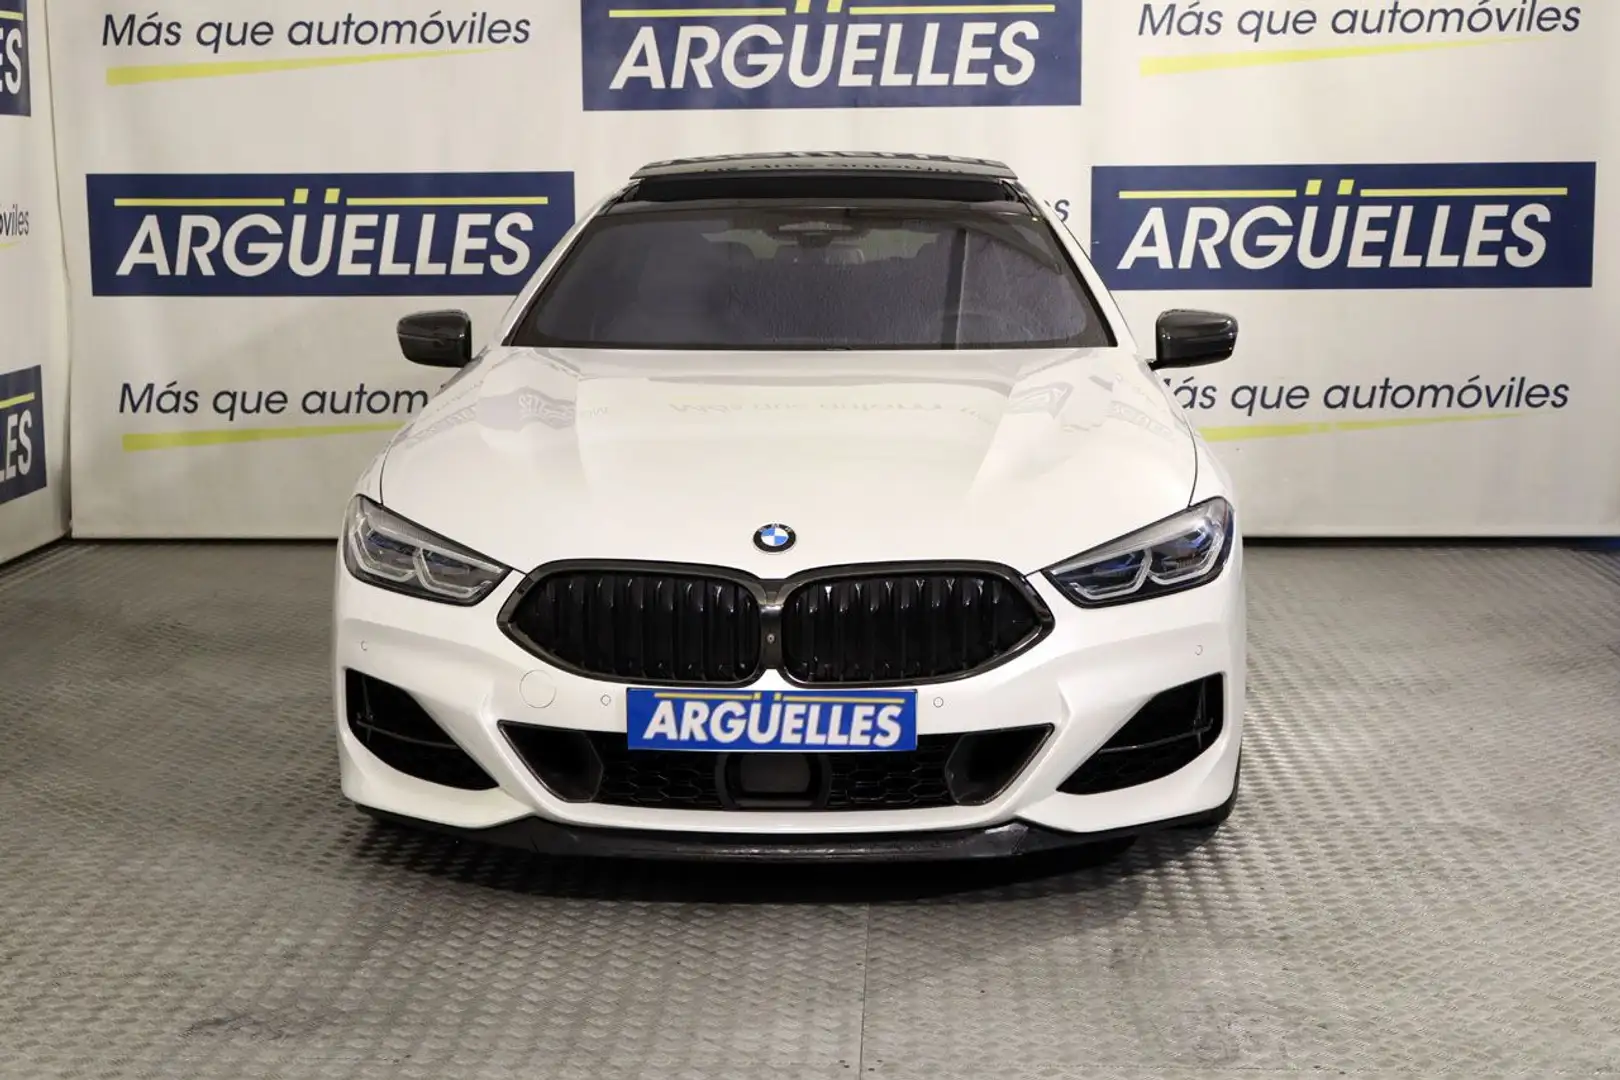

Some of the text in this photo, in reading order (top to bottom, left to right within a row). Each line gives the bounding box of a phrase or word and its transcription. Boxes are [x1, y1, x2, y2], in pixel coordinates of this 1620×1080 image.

[102, 11, 531, 54] Más que automóviles
[609, 0, 1040, 90] ARGÜELLES
[1138, 0, 1582, 43] Más que automóviles
[115, 188, 535, 278] ARGÜELLES
[1116, 179, 1552, 270] ARGÜELLES
[118, 381, 200, 414] Más
[212, 391, 289, 422] que
[1163, 375, 1570, 417] ás que automóviles
[643, 692, 904, 748] ARGÜELLES
